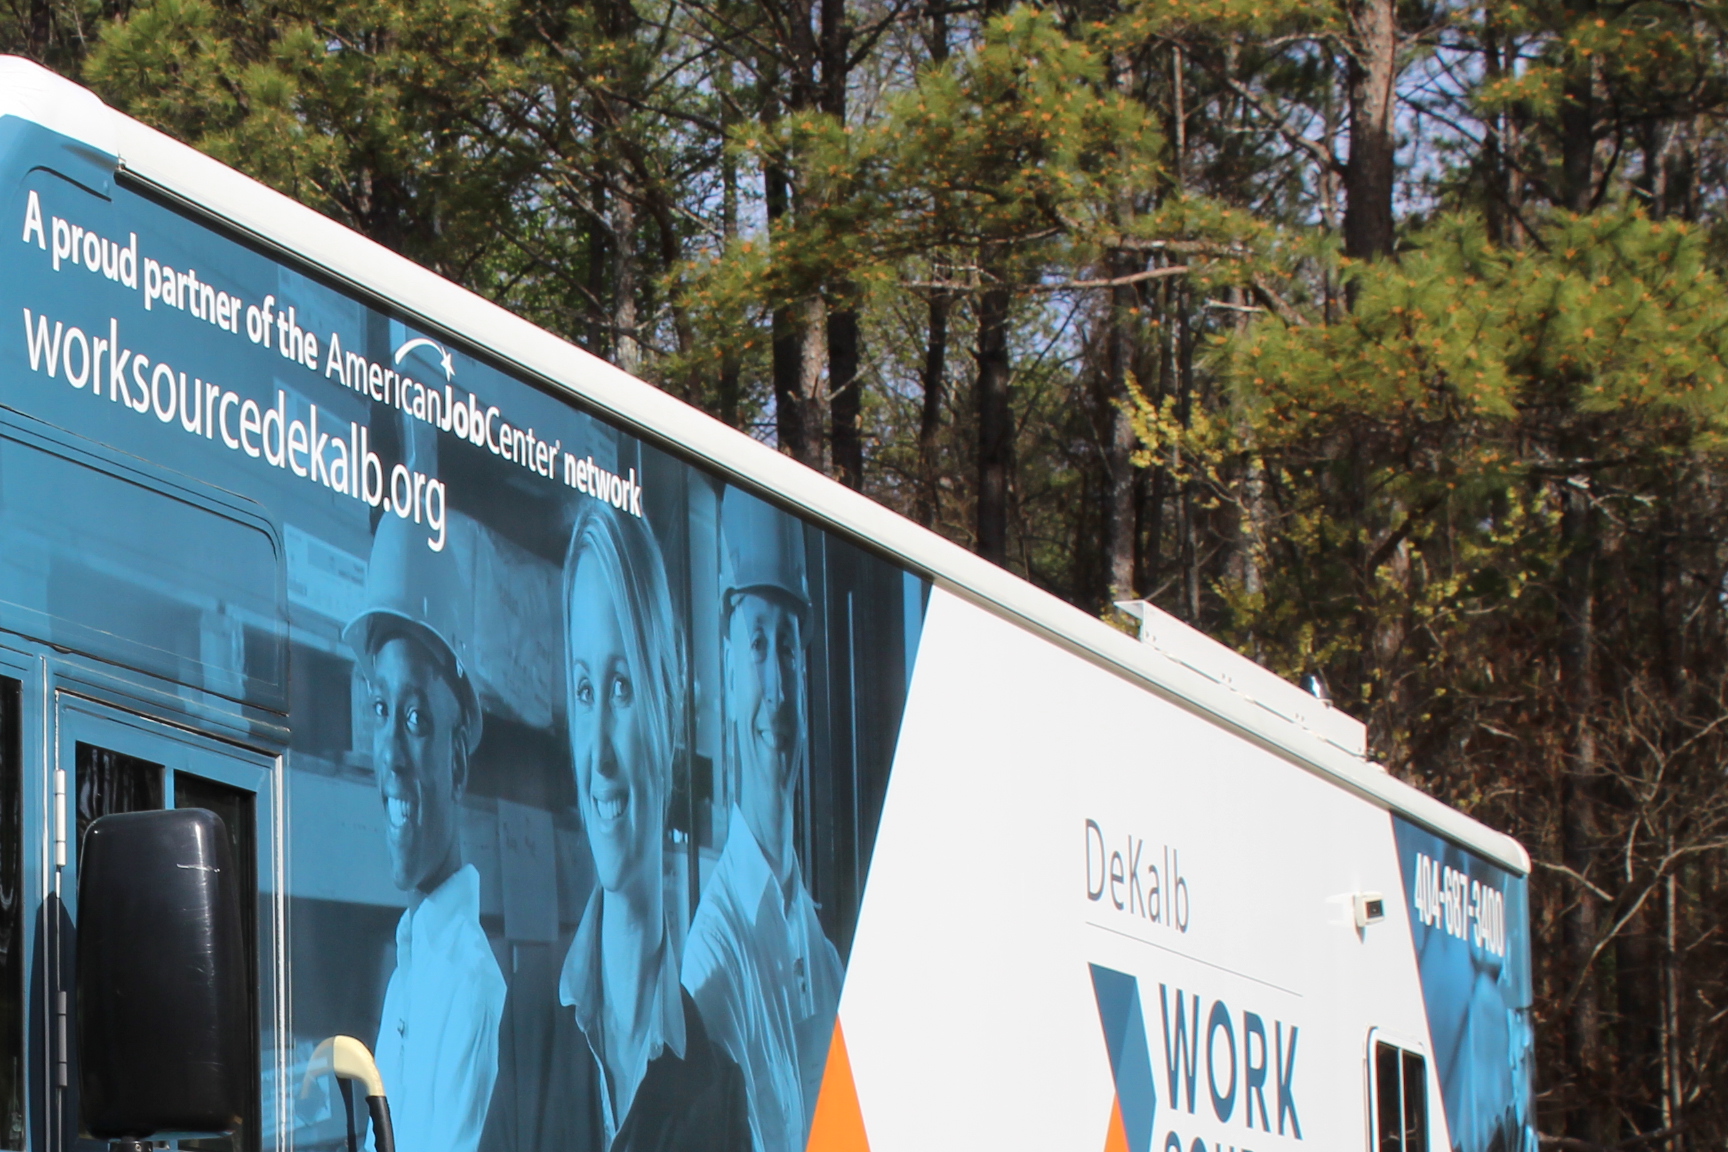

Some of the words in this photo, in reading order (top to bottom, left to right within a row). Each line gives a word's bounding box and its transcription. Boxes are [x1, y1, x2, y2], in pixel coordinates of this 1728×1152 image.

[22, 190, 47, 249] A
[51, 213, 138, 289] proud
[144, 257, 242, 334] partner
[245, 295, 275, 347] of
[277, 305, 318, 371] the
[563, 451, 642, 518] network
[23, 307, 446, 553] worksourcedekalb.org
[1085, 818, 1190, 934] DeKalb
[1414, 852, 1506, 958] 404-687-3400
[1158, 982, 1303, 1141] WORK
